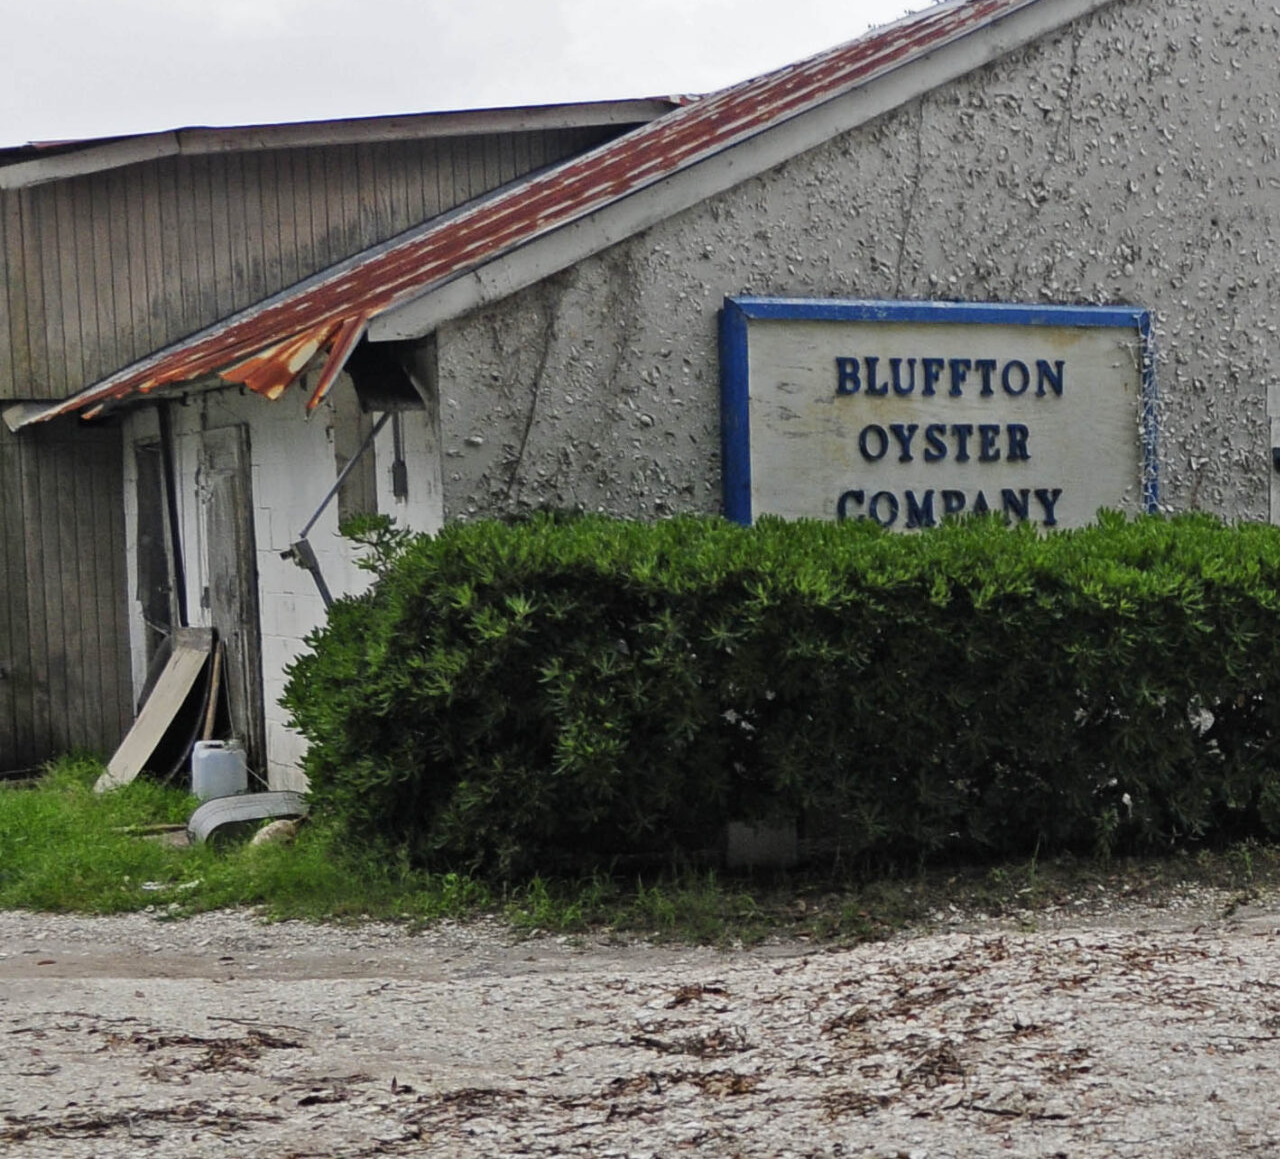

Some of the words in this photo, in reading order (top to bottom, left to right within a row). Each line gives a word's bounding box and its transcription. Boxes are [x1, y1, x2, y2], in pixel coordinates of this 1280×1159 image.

[835, 356, 1065, 396] BLUFFTON
[858, 424, 1031, 462] OYSTER
[837, 489, 1063, 528] COMPANY
